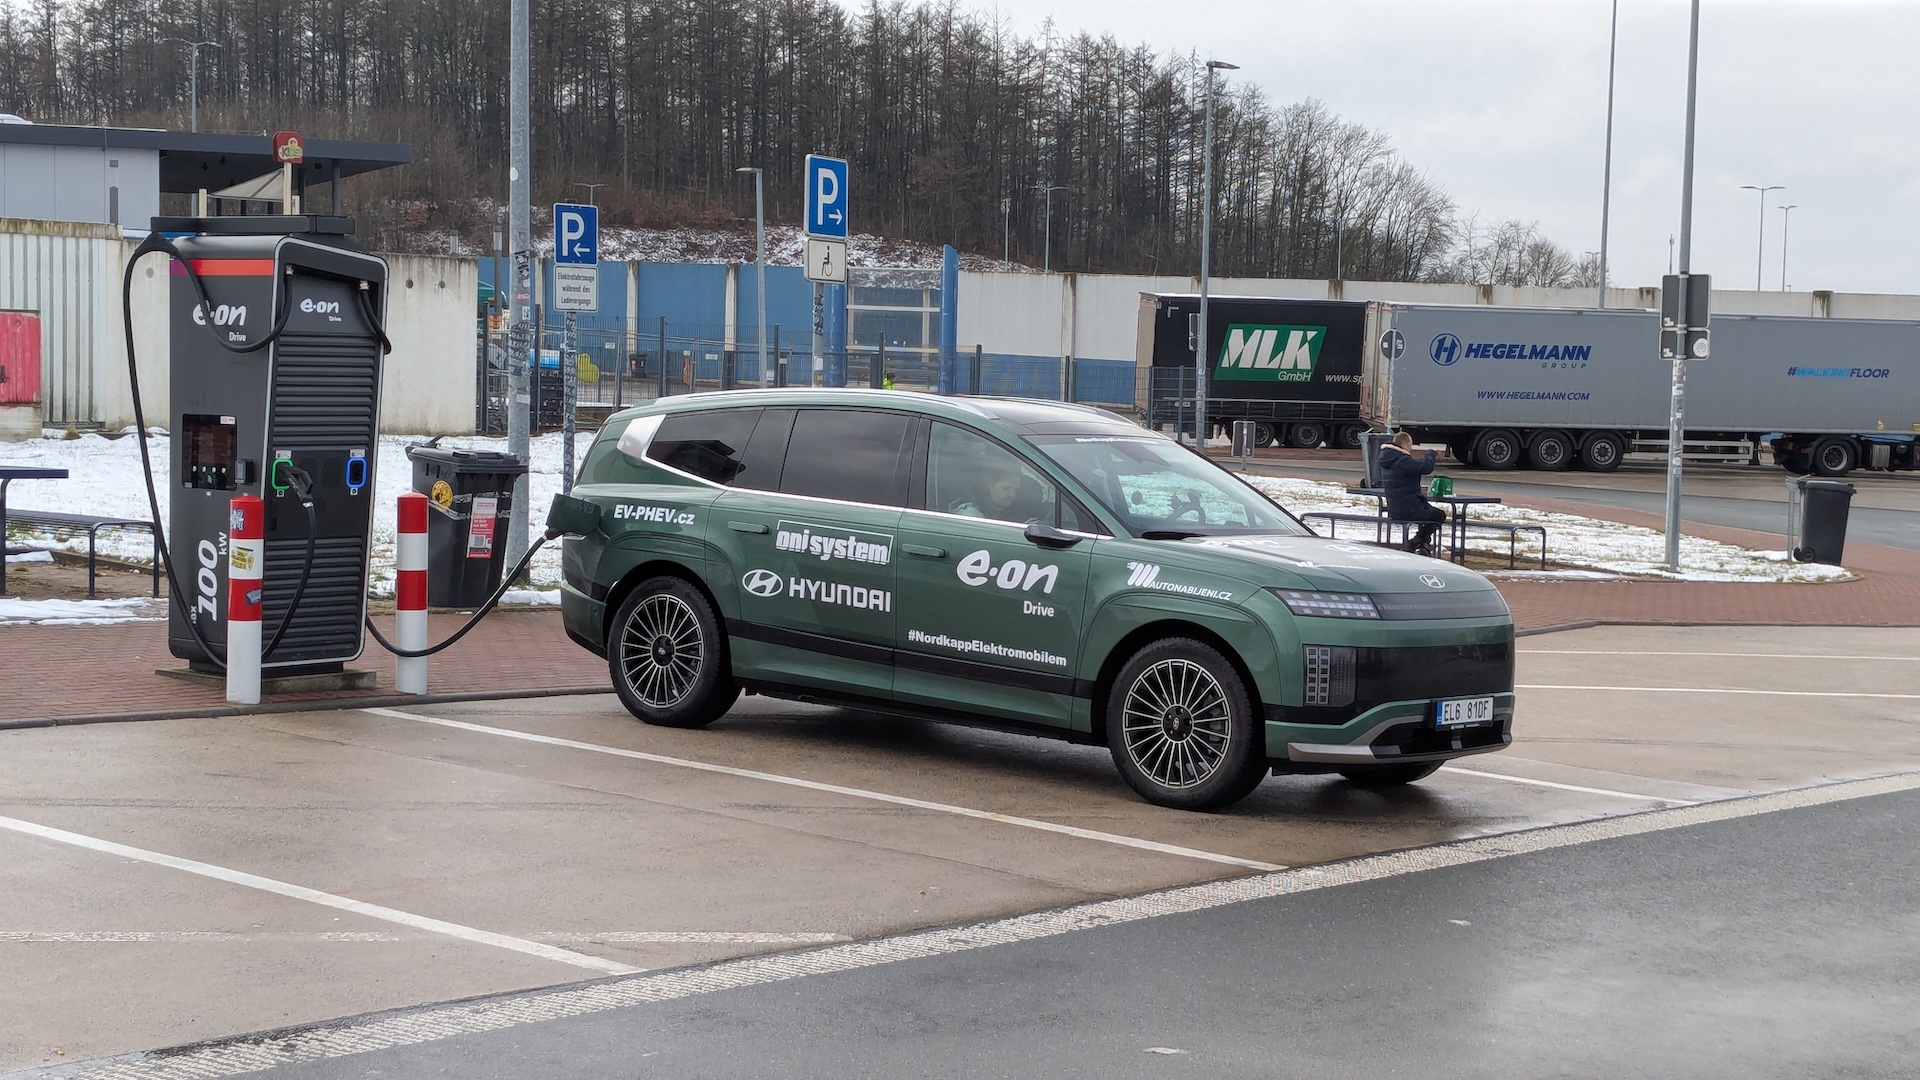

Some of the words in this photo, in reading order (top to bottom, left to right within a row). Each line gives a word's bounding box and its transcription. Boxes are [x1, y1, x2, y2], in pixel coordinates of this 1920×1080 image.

[817, 167, 839, 226] P
[561, 211, 585, 257] P
[228, 332, 247, 342] Drive
[1220, 328, 1318, 370] MLK
[1464, 342, 1592, 361] HEGELMANN
[1278, 370, 1313, 382] GmbH
[1477, 390, 1590, 401] WWW.HEGELMANN.COM
[613, 504, 695, 525] EV-PHEV.cz
[218, 531, 228, 555] kW
[197, 539, 218, 621] 100
[1148, 580, 1232, 601] AUTONABIJENI.CZ
[788, 577, 892, 613] HYUNDAI
[1023, 600, 1055, 617] Drive
[907, 629, 1067, 667] #NordkappElektromobilem
[1444, 703, 1461, 721] EL6
[1467, 700, 1489, 719] 81DF
